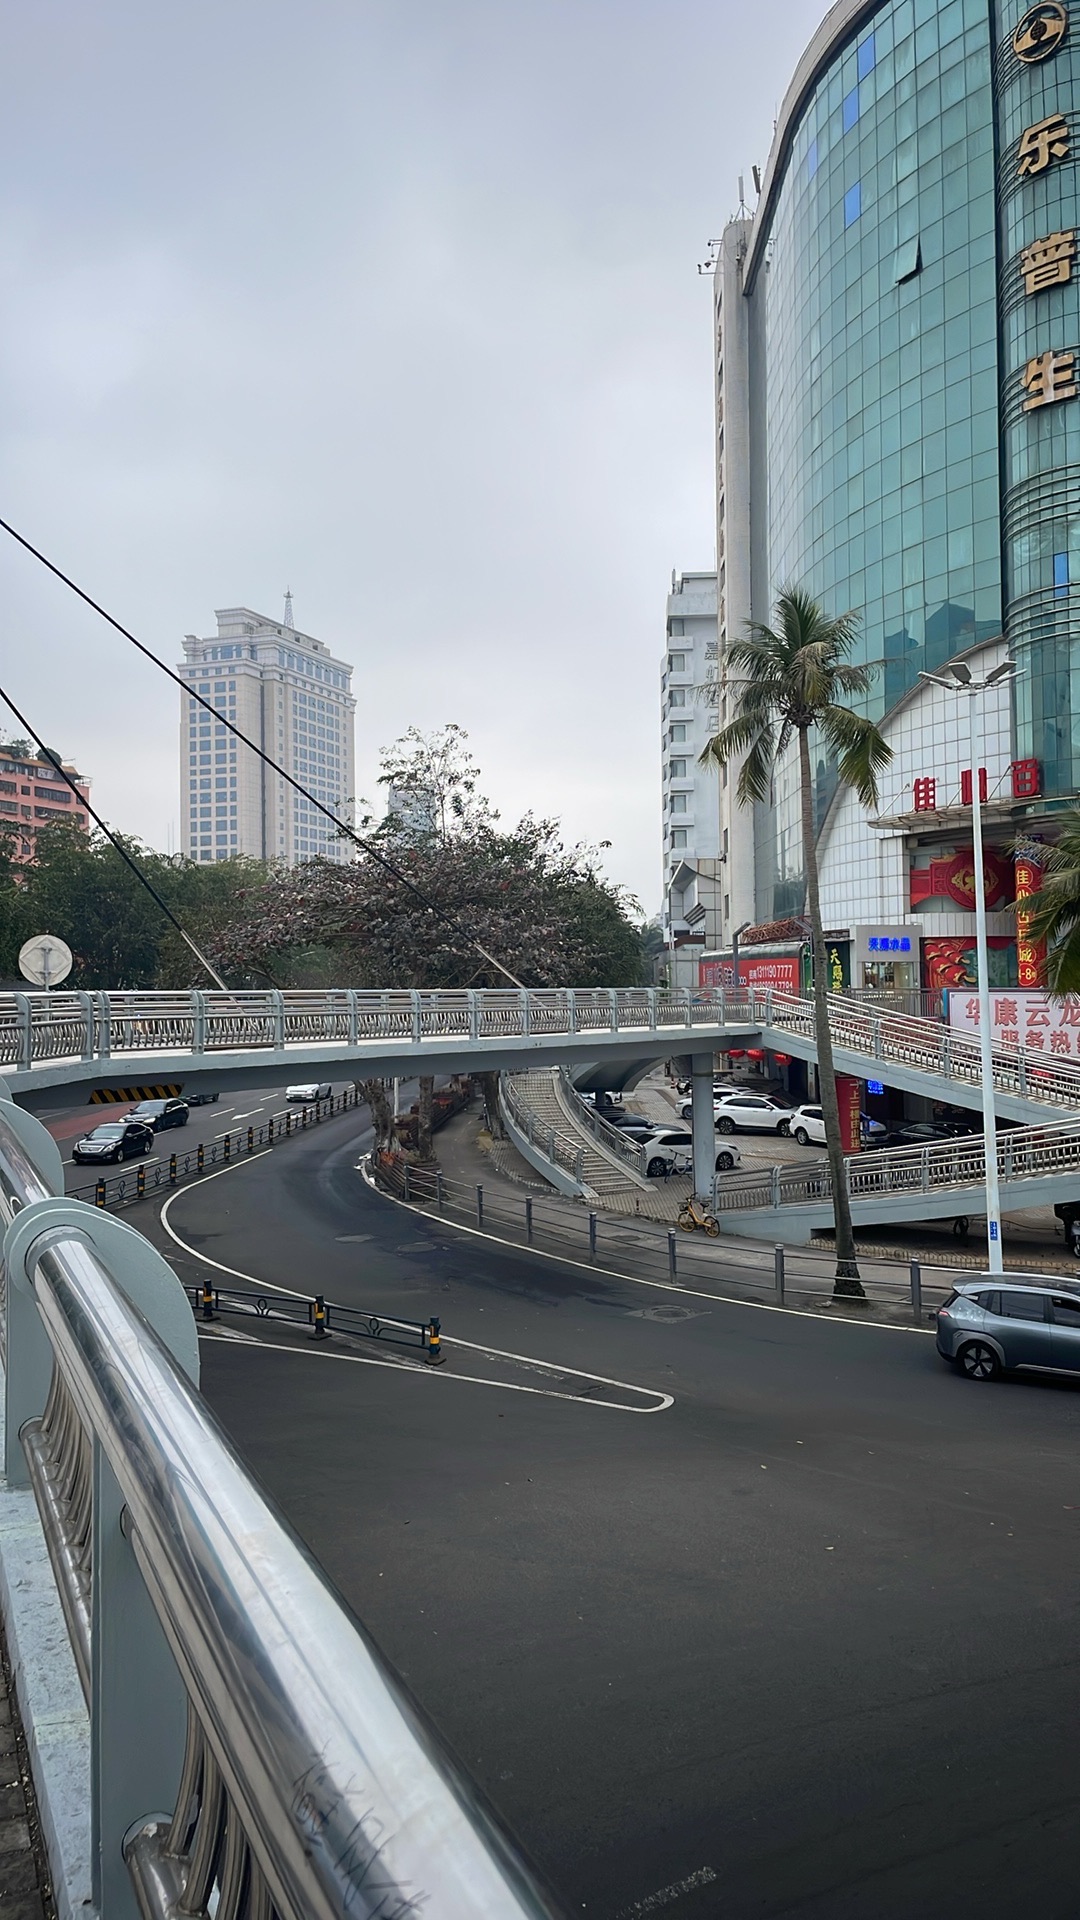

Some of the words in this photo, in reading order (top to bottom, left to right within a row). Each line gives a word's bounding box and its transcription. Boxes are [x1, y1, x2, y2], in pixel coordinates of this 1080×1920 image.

[1016, 112, 1077, 412] 乐普生
[1001, 1030, 1080, 1053] 服务热
